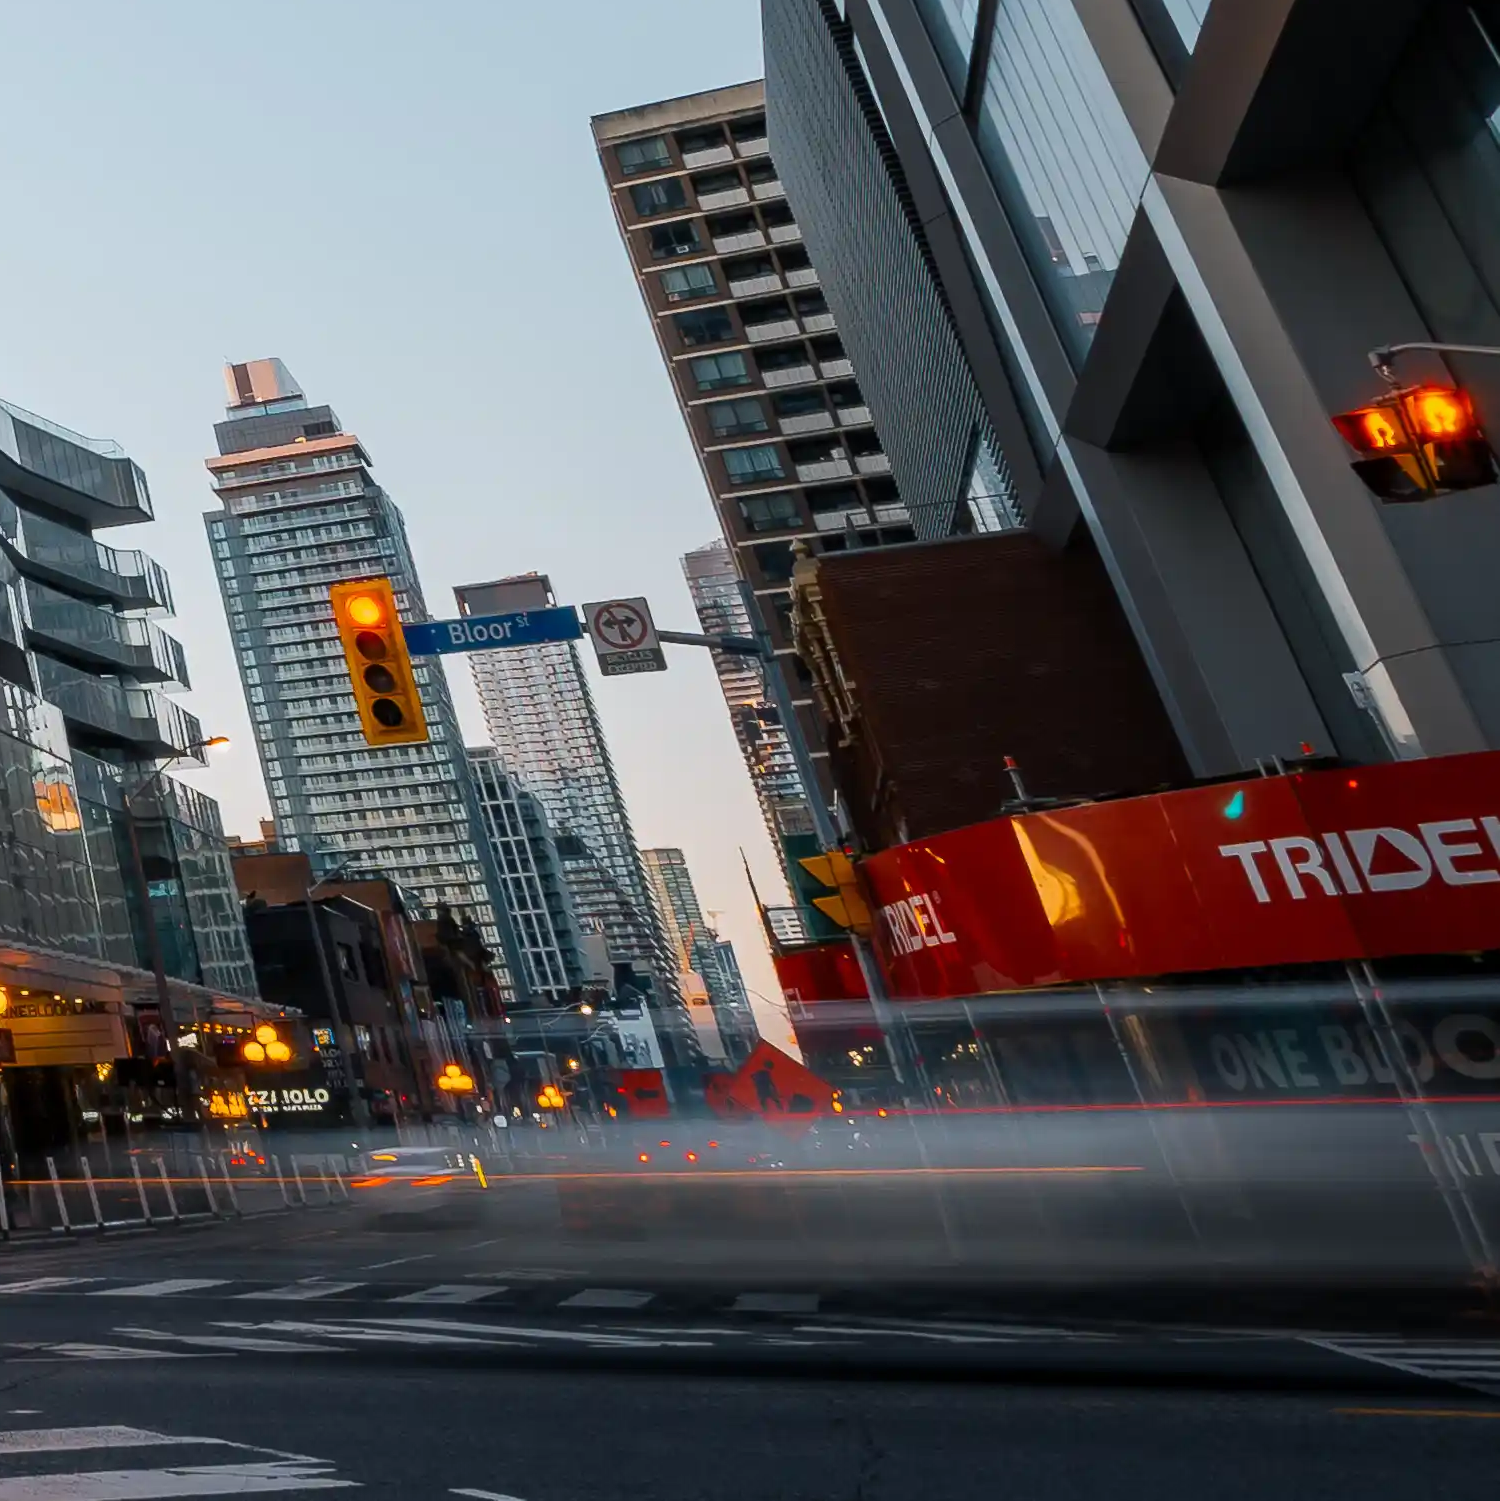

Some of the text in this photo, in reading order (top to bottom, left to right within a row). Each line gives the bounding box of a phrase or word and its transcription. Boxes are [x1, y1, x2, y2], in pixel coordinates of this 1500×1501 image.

[449, 616, 531, 646] Bloor St
[606, 651, 654, 665] BICYCLES
[607, 660, 658, 676] EXCEPTED
[1209, 1028, 1320, 1091] ONE
